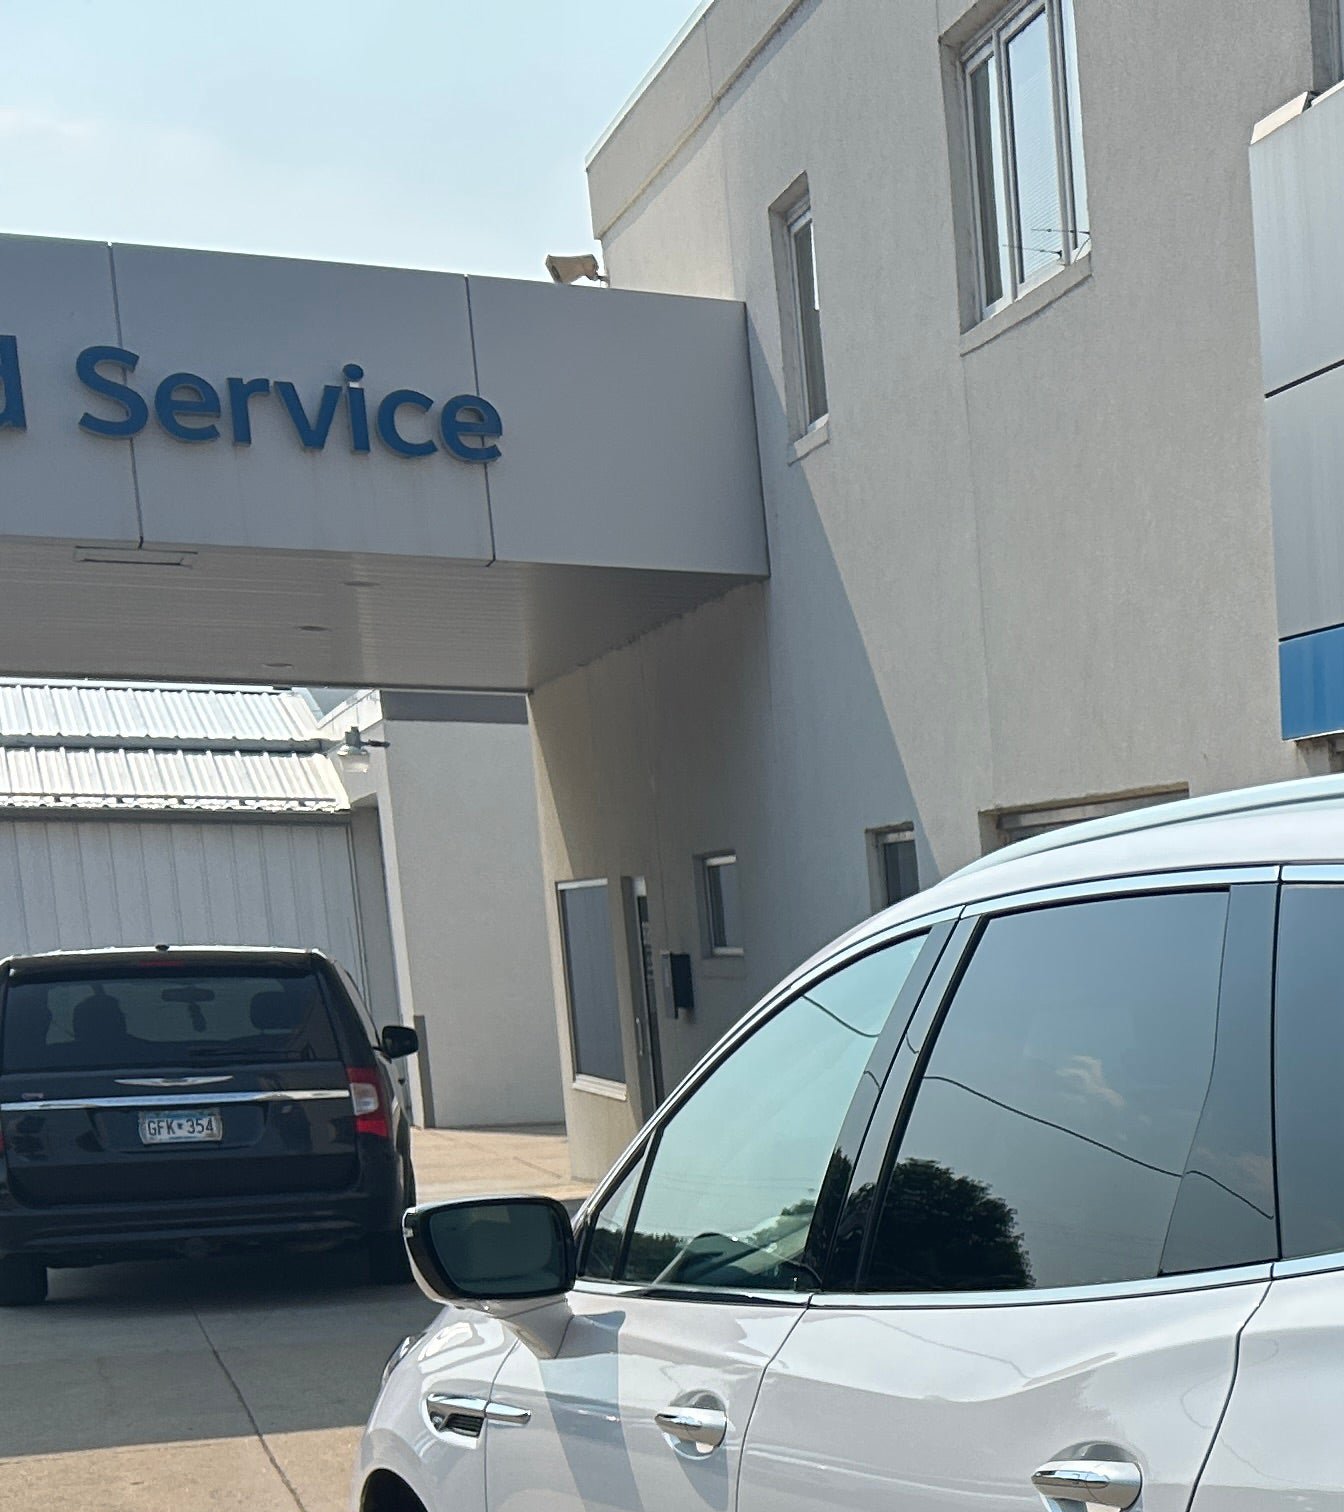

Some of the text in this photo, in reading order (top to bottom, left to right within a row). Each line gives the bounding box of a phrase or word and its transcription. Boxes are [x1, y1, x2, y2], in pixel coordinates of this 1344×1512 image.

[76, 345, 503, 464] Service
[148, 1117, 214, 1136] GFK 354
